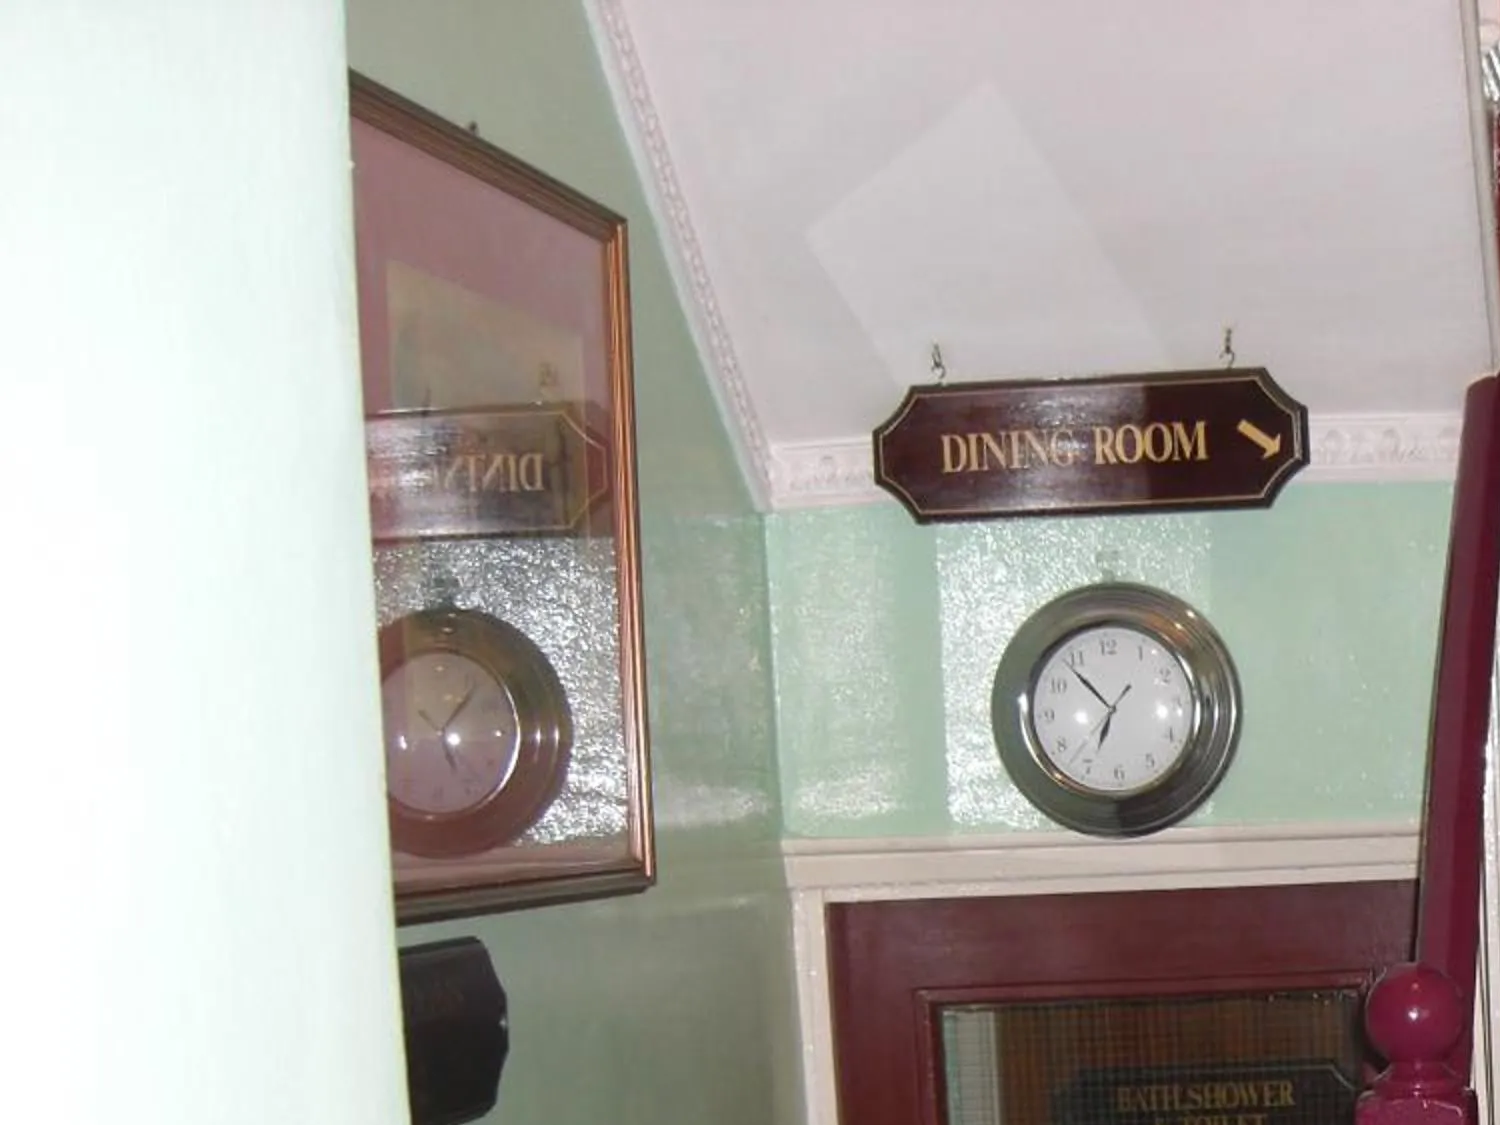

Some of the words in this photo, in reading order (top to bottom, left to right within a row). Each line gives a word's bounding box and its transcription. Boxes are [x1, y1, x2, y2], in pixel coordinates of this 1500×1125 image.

[939, 427, 1076, 473] DINING
[1092, 421, 1209, 465] ROOM
[1100, 638, 1118, 656] 12
[1051, 677, 1068, 694] 10
[1044, 708, 1055, 723] 9
[1113, 764, 1125, 780] 6
